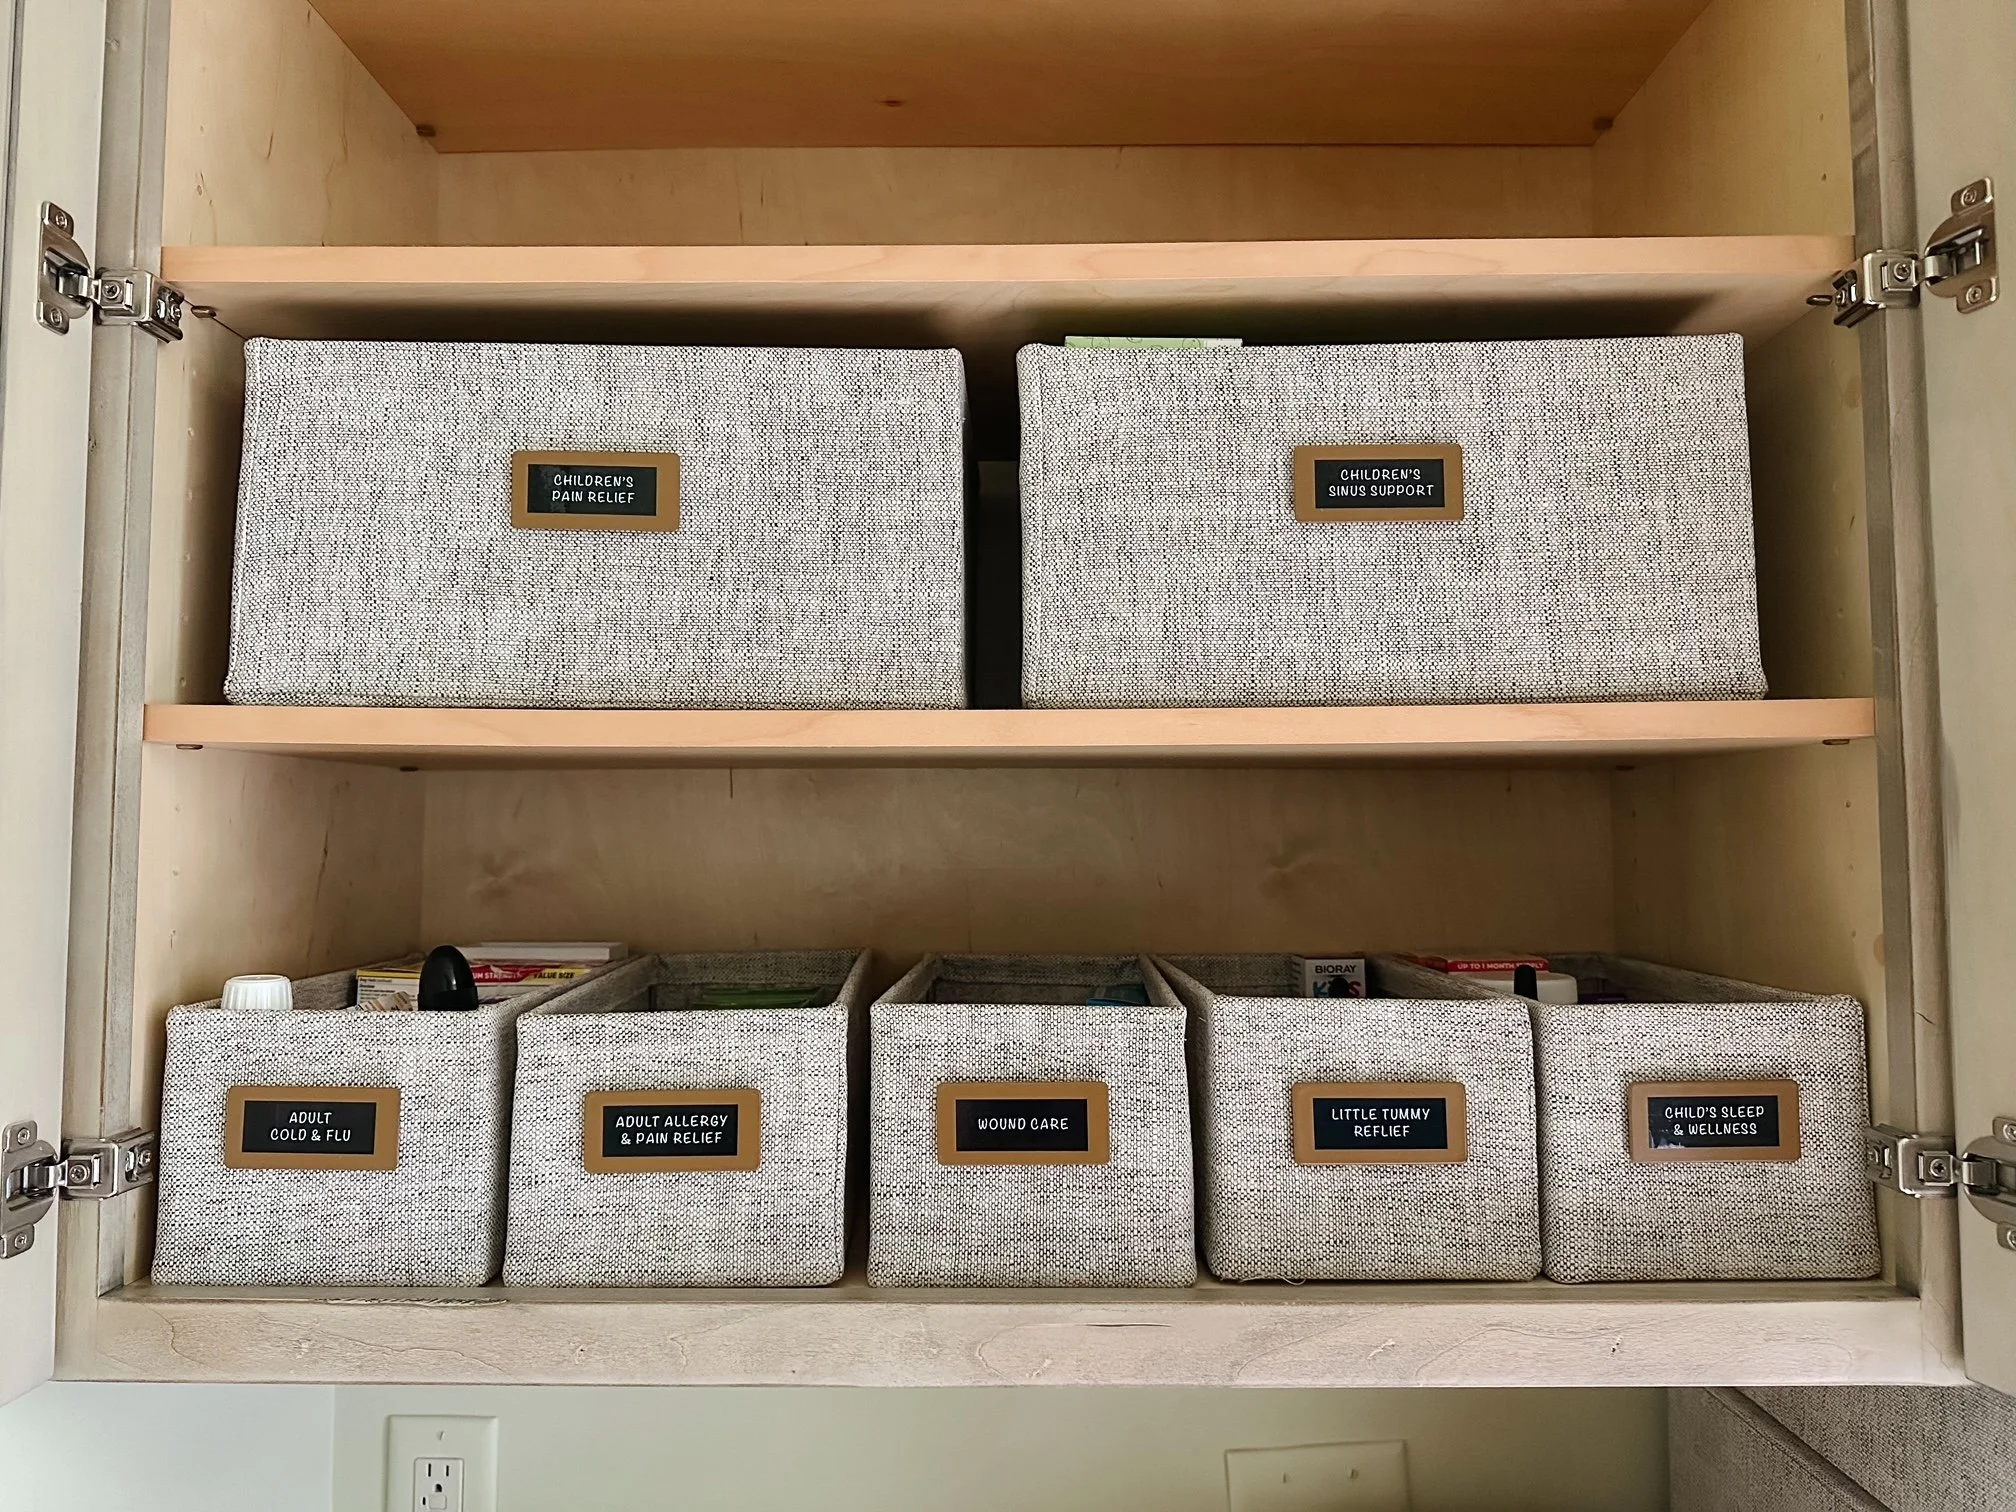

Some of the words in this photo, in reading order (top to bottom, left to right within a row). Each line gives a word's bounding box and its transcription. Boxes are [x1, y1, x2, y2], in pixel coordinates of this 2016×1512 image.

[553, 473, 634, 488] CHILDREN'S
[1340, 468, 1421, 481] CHILDREN'S
[551, 490, 583, 502] PAIN
[587, 490, 636, 504] RELIEF
[1328, 484, 1367, 497] SINUS
[1370, 484, 1434, 497] SUPPORT
[1315, 965, 1356, 974] BIORAY
[1457, 962, 1469, 970] UP
[1470, 962, 1482, 970] TO
[1486, 962, 1515, 970] MONTH
[288, 1111, 333, 1125] ADULT
[1331, 1108, 1378, 1121] LITTLE
[1381, 1107, 1431, 1121] TUMMY
[1664, 1106, 1717, 1119] CHILD'S
[1721, 1105, 1765, 1119] SLEEP
[615, 1115, 660, 1128] ADULT
[664, 1114, 728, 1128] ALLERGY
[977, 1117, 1026, 1131] WOUND
[1030, 1117, 1069, 1131] CARE
[270, 1127, 307, 1141] COLD
[310, 1128, 321, 1142] &
[326, 1129, 351, 1142] FLU
[1353, 1124, 1410, 1138] REFLIEF
[1673, 1123, 1684, 1136] &
[1688, 1122, 1758, 1136] WELLNESS
[620, 1132, 632, 1145] &
[635, 1132, 669, 1145] PAIN
[673, 1131, 723, 1145] RELIEF
